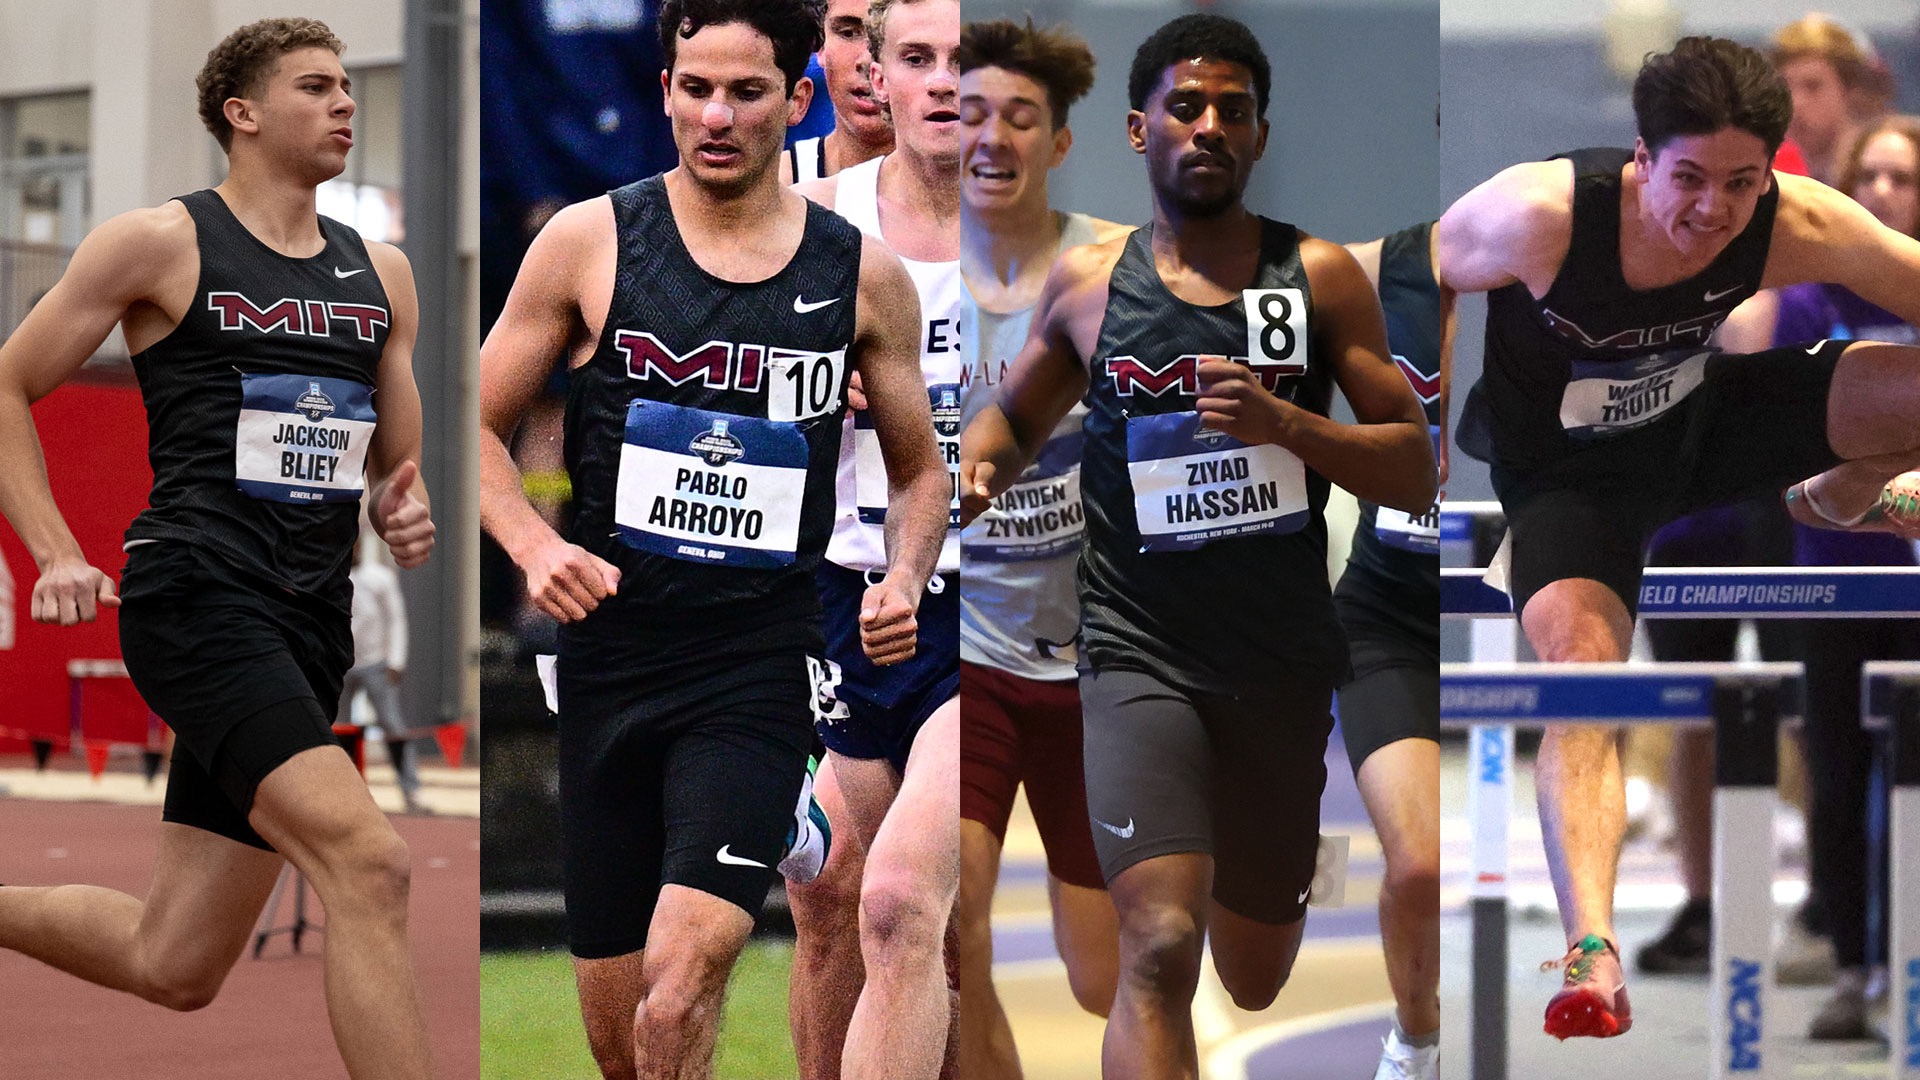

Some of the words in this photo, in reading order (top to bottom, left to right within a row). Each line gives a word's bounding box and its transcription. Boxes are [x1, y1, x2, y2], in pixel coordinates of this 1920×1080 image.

[208, 291, 388, 342] MIT
[1259, 294, 1295, 360] 8
[615, 329, 815, 394] MI
[785, 357, 833, 417] 10
[1602, 379, 1674, 422] TRUITT
[273, 423, 350, 451] JACKSON
[281, 451, 339, 482] BLIEY
[675, 468, 748, 500] PABLO
[1186, 457, 1249, 486] ZIYAD
[648, 496, 763, 540] ARROYO
[993, 484, 1066, 511] JAYDEN
[1166, 481, 1278, 524] HASSAN
[985, 502, 1083, 538] ZYWICKI
[1681, 584, 1837, 604] CHAMPIONSHIPS
[1728, 956, 1762, 1071] NCAA
